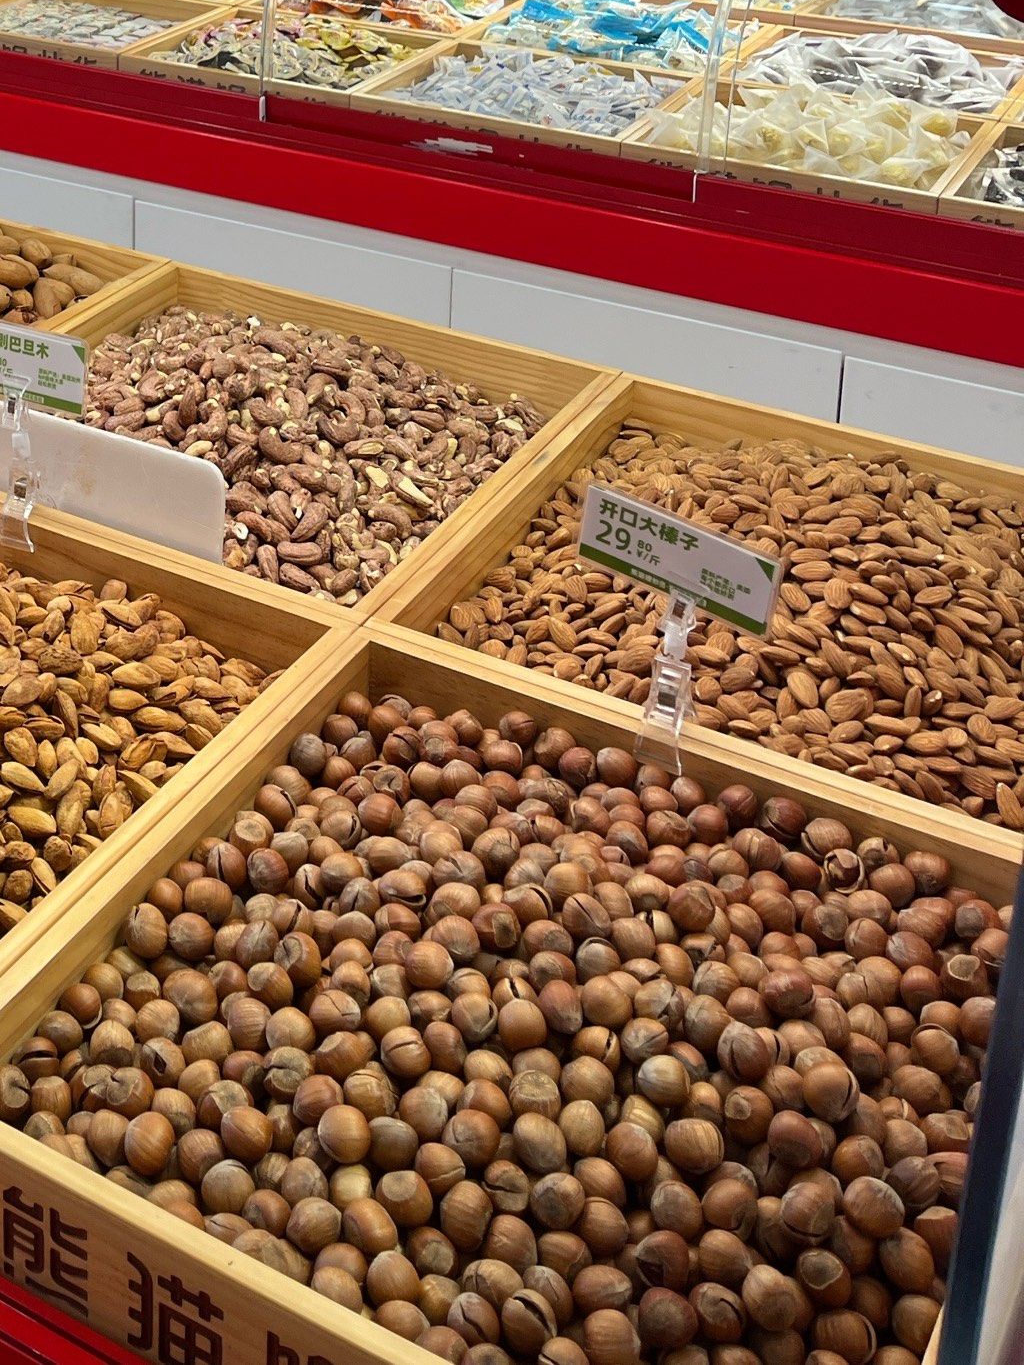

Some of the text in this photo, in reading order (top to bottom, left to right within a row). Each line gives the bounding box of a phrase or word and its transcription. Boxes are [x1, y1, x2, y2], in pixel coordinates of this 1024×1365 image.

[600, 498, 699, 551] 开口大榛子
[2, 1185, 338, 1365] 熊猫
